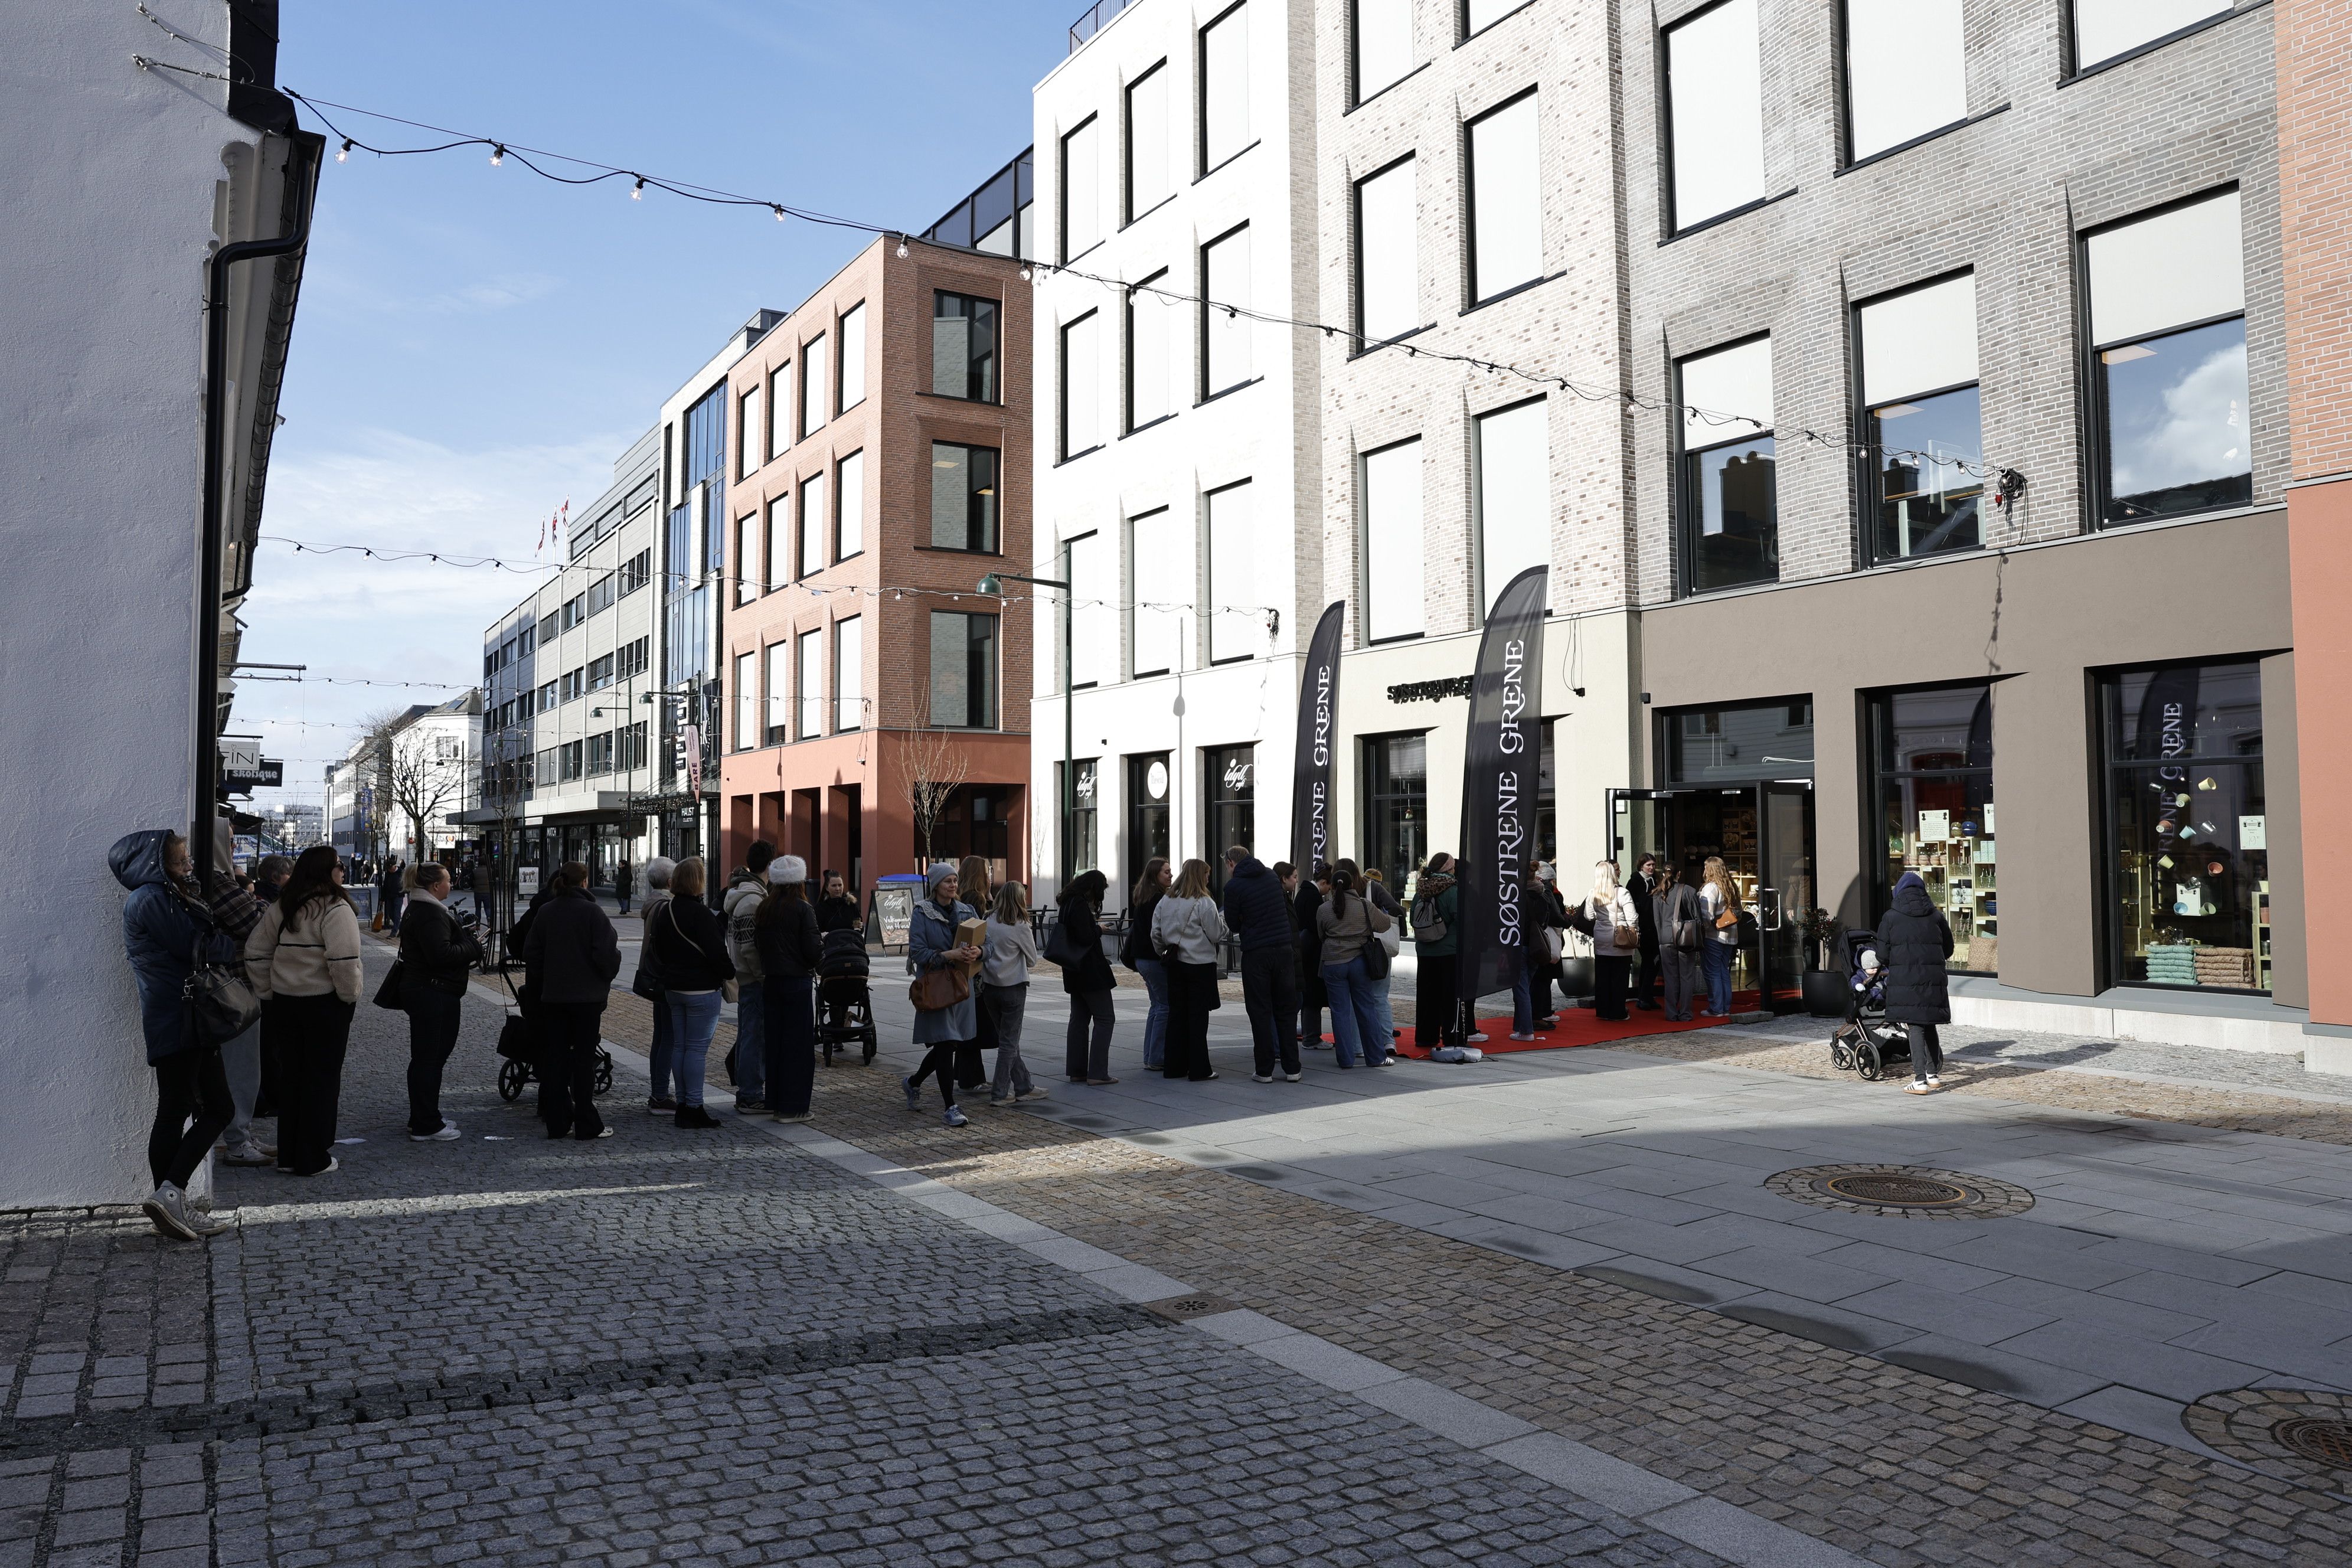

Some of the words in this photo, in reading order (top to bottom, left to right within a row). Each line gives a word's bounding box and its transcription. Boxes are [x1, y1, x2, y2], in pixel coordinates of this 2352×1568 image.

[1499, 639, 1525, 754] GRENE
[1314, 665, 1330, 766] GRENE
[1077, 771, 1098, 797] idyll
[1224, 759, 1253, 788] idyll
[681, 806, 695, 816] HAUST
[1498, 770, 1524, 946] SØSTRENE
[884, 894, 908, 910] idyll
